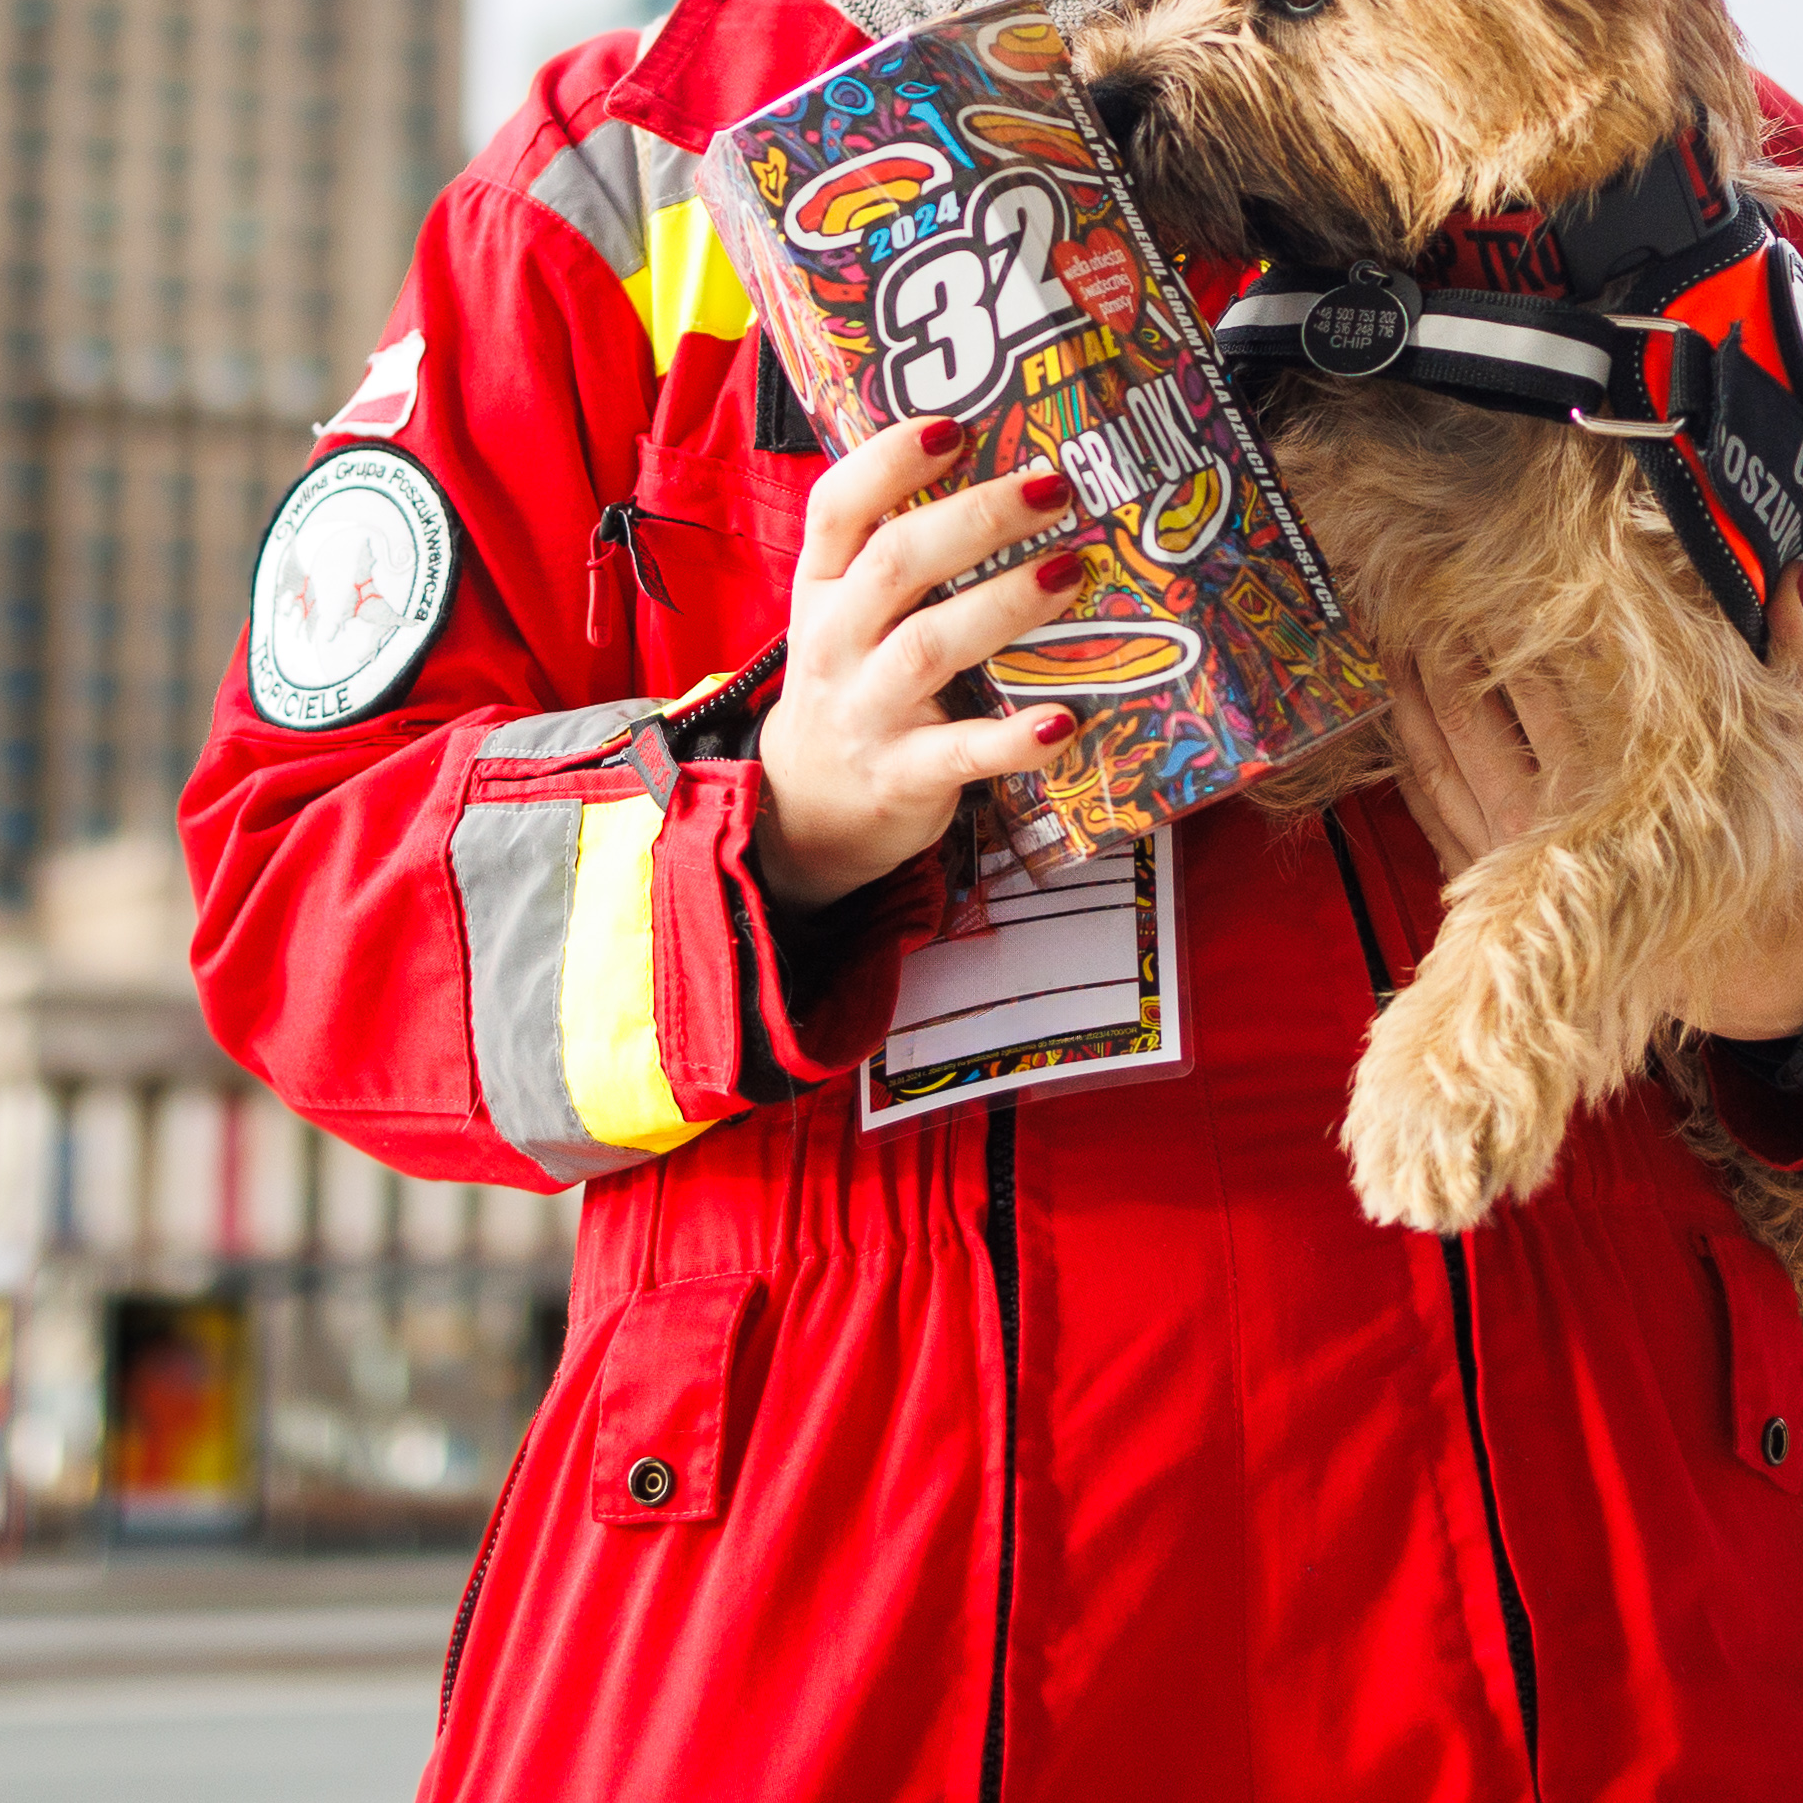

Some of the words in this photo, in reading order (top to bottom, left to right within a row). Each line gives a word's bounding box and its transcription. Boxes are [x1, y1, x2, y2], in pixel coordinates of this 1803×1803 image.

[867, 190, 961, 264] 2024
[895, 184, 1075, 412] 32
[1336, 307, 1355, 321] 503
[1358, 308, 1376, 323] 753
[1378, 310, 1397, 324] 202
[1021, 324, 1121, 397] FINAŁ
[1053, 72, 1100, 140] PŁUCA
[1089, 143, 1115, 172] PO
[1105, 175, 1170, 282] PANDEMII.
[1161, 284, 1210, 358] GRAMY
[1200, 363, 1232, 404] DLA
[1223, 407, 1269, 476] DZIECI
[1265, 491, 1342, 624] DOROSŁYCH.
[1329, 334, 1373, 350] CHIP
[274, 475, 329, 541] Cywilna
[334, 461, 387, 482] Grupa
[388, 467, 444, 622] Poszukiwawcza
[251, 634, 354, 720] TROPICIELE
